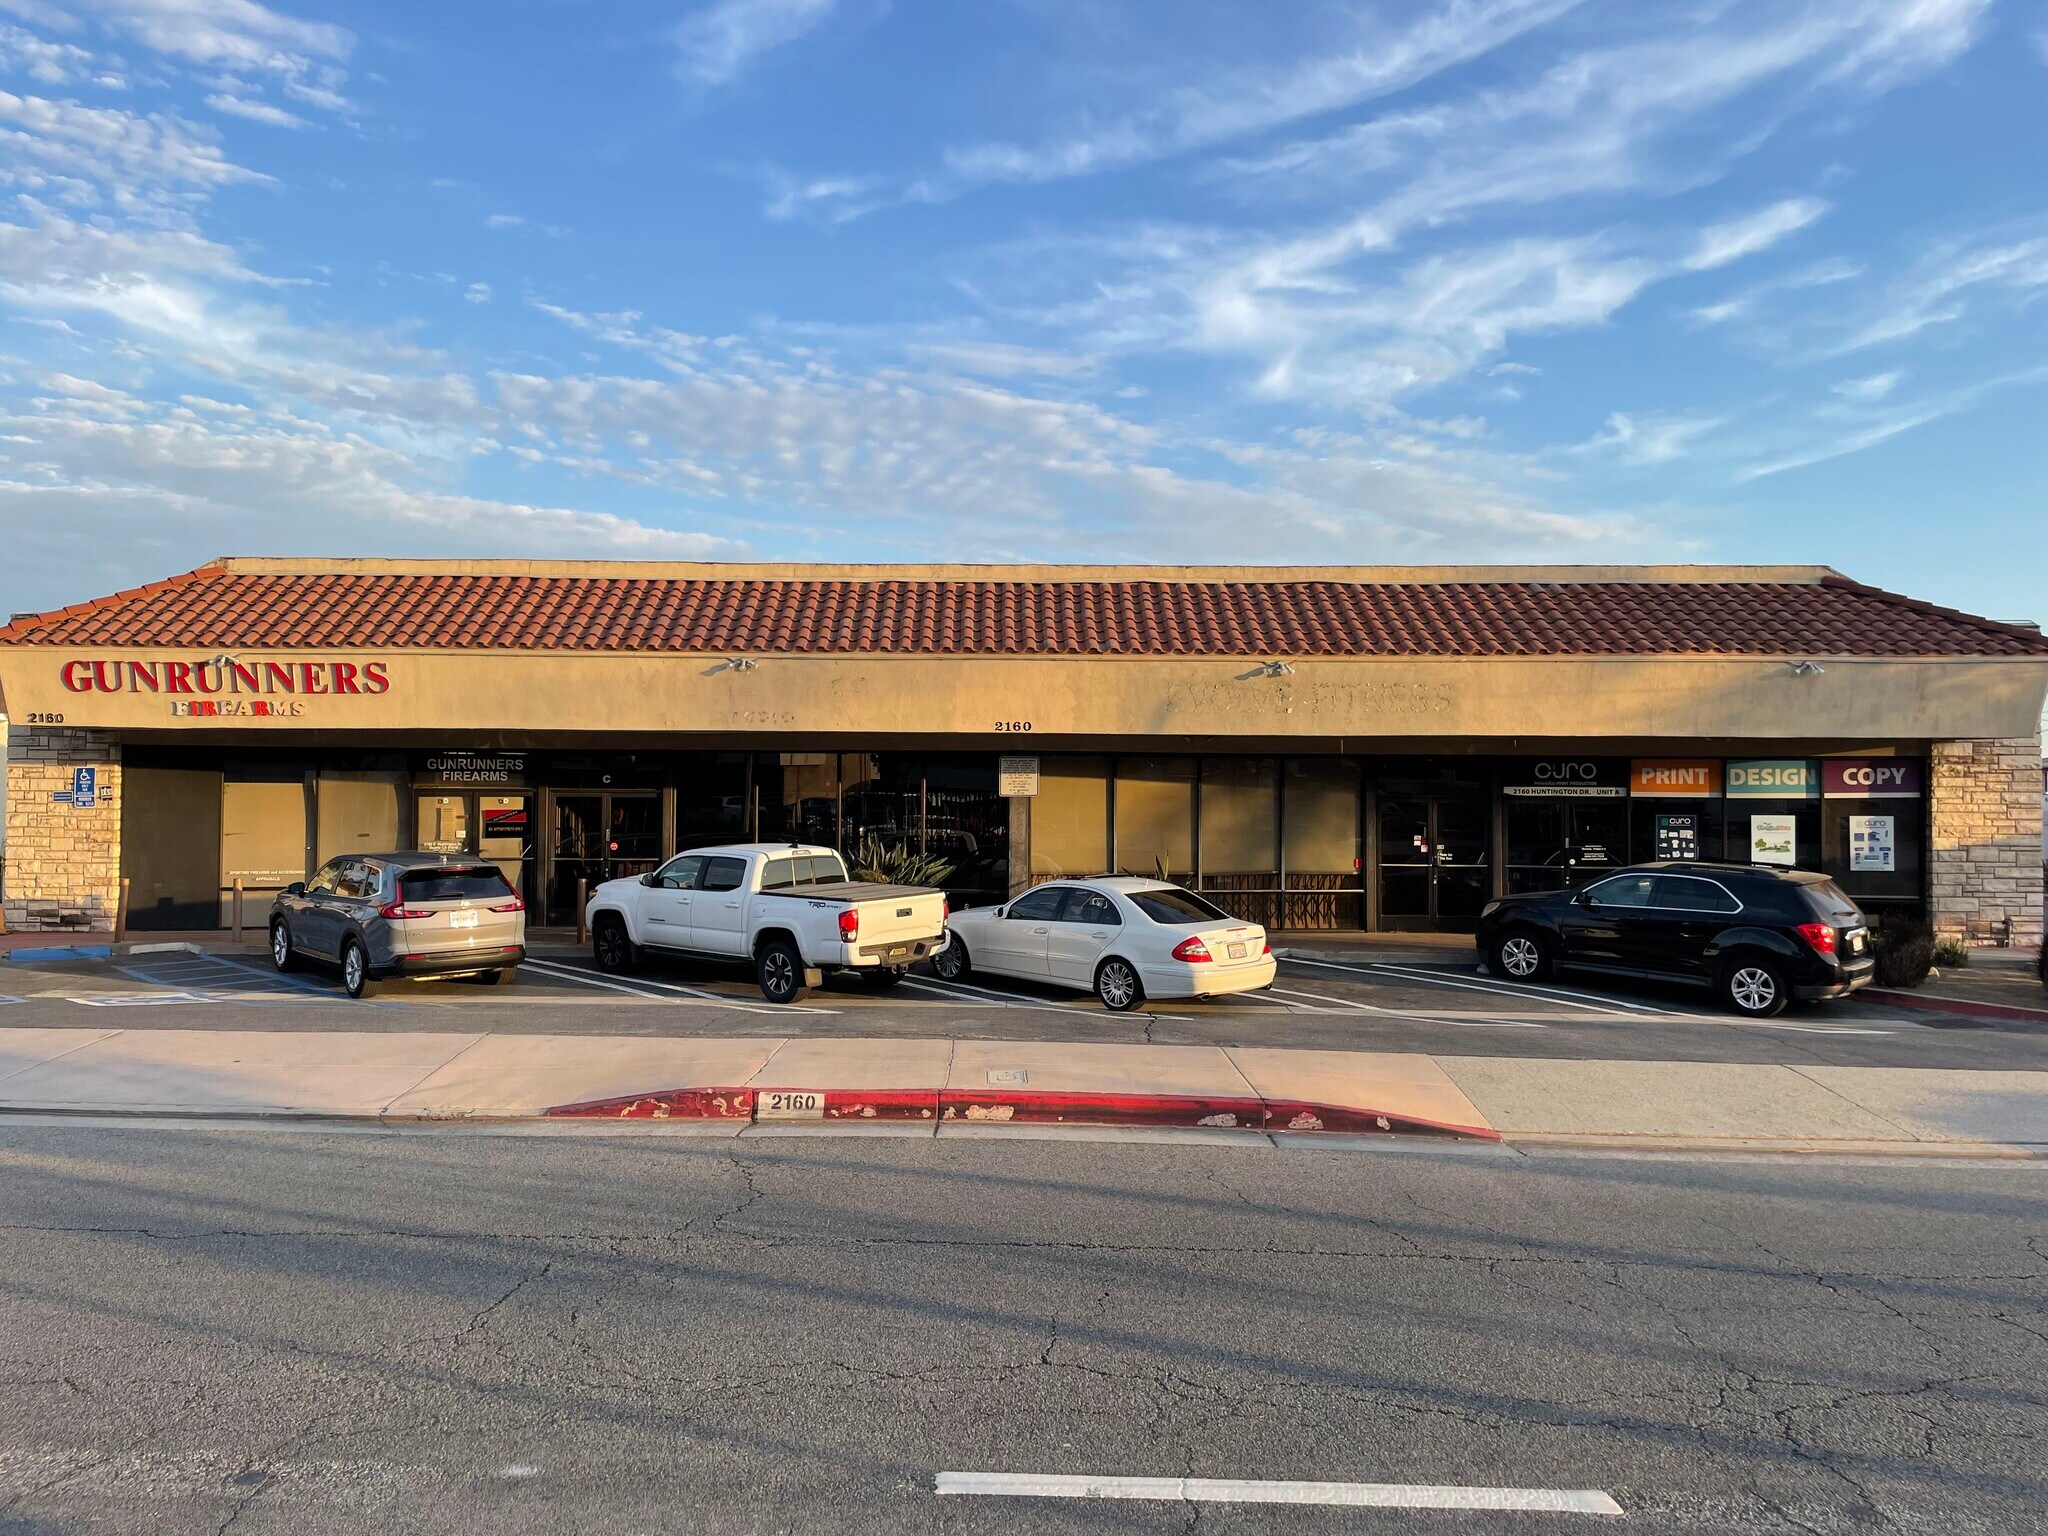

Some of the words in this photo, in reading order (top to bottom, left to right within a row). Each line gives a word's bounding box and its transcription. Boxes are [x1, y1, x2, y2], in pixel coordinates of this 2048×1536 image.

[61, 660, 391, 694] GUNRUNNERS
[173, 701, 306, 716] FIREARMS
[29, 712, 64, 723] 2160
[994, 721, 1032, 732] 2160
[427, 758, 524, 770] GUNRUNNERS
[442, 771, 508, 782] FIREARMS
[602, 774, 611, 783] C
[1641, 767, 1709, 785] PRINT
[1729, 768, 1816, 786] DESIGN
[1842, 767, 1907, 785] COPY
[771, 1094, 815, 1110] 2160
